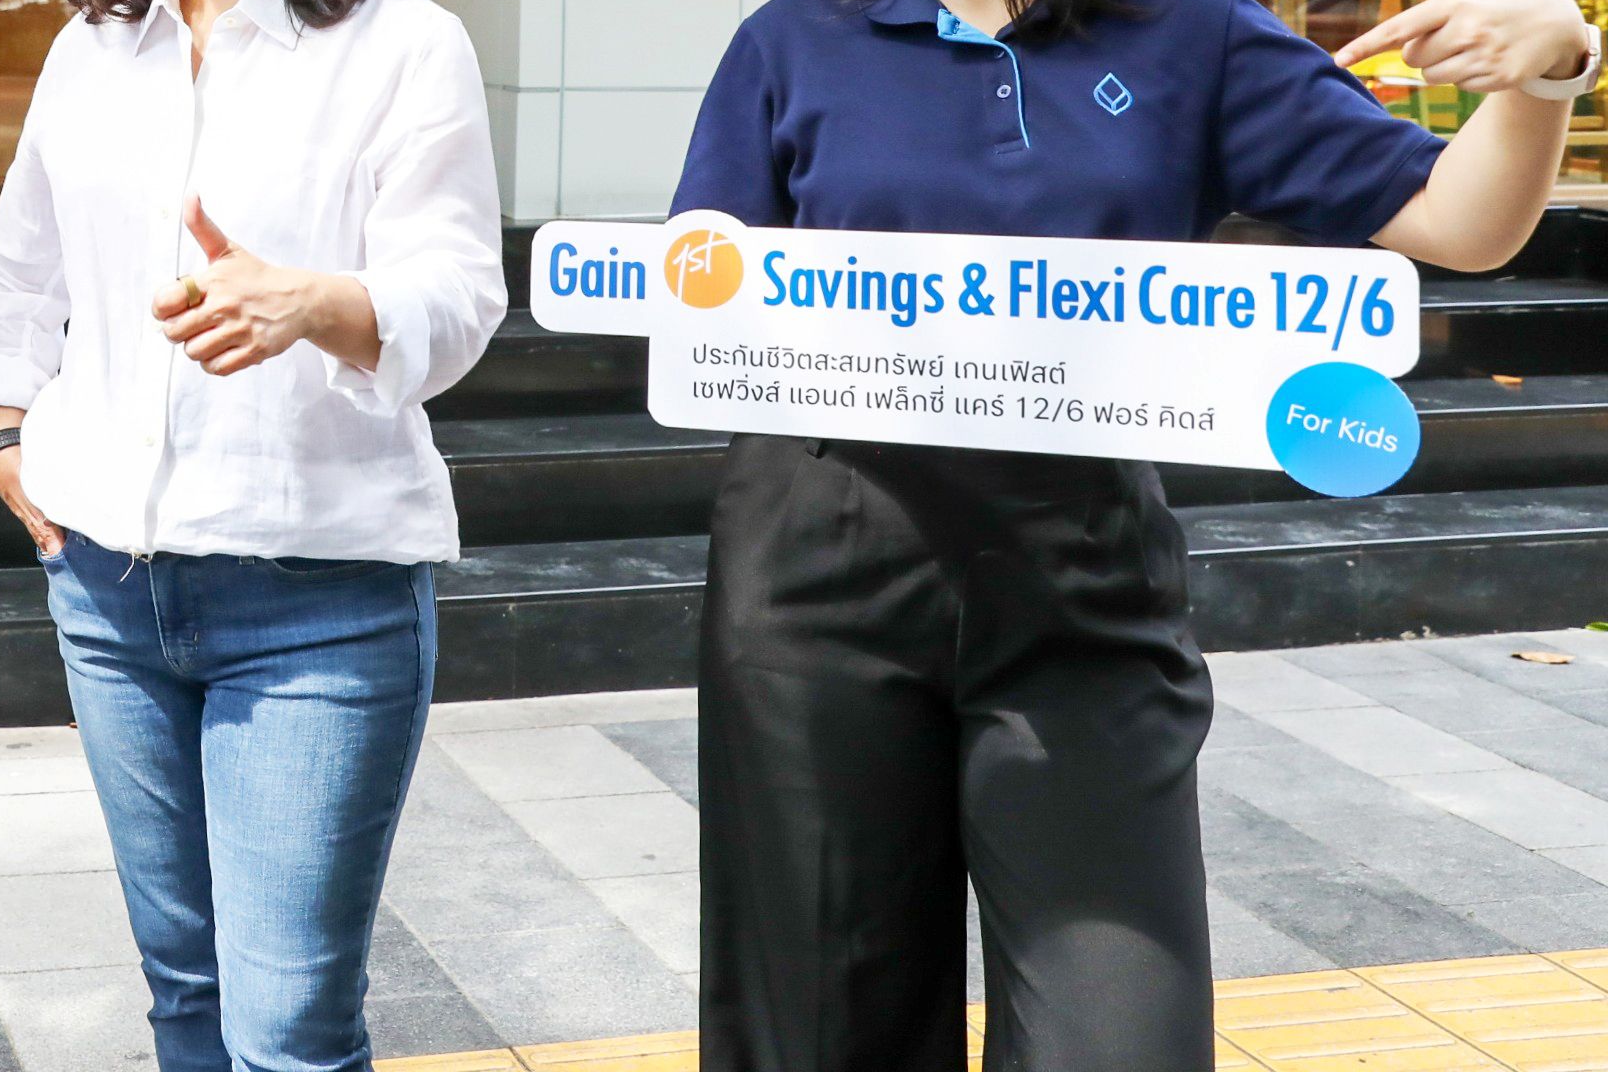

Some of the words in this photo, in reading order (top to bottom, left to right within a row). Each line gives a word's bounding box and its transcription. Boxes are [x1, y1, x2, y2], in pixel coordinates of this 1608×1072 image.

[550, 243, 645, 299] Gain
[671, 230, 739, 301] 1st
[764, 251, 944, 327] Savings
[959, 263, 994, 315] &
[1010, 260, 1124, 322] Flexi
[1139, 266, 1254, 328] Care
[1272, 272, 1394, 350] 12/6
[693, 343, 944, 378] ประกันชีวิตสะสมทรัพย์
[955, 361, 1065, 384] เกนเฟิสต์
[692, 374, 780, 404] เซฟวิ่งส์
[789, 384, 856, 408] แอนด์
[866, 386, 945, 413] เฟล็กซี่
[954, 394, 1004, 417] แคร์
[1018, 397, 1083, 422] 12/6
[1094, 403, 1147, 425] ฟอร์
[1160, 407, 1213, 430] คิดส์
[1286, 400, 1331, 434] For
[1337, 414, 1399, 453] Kids
